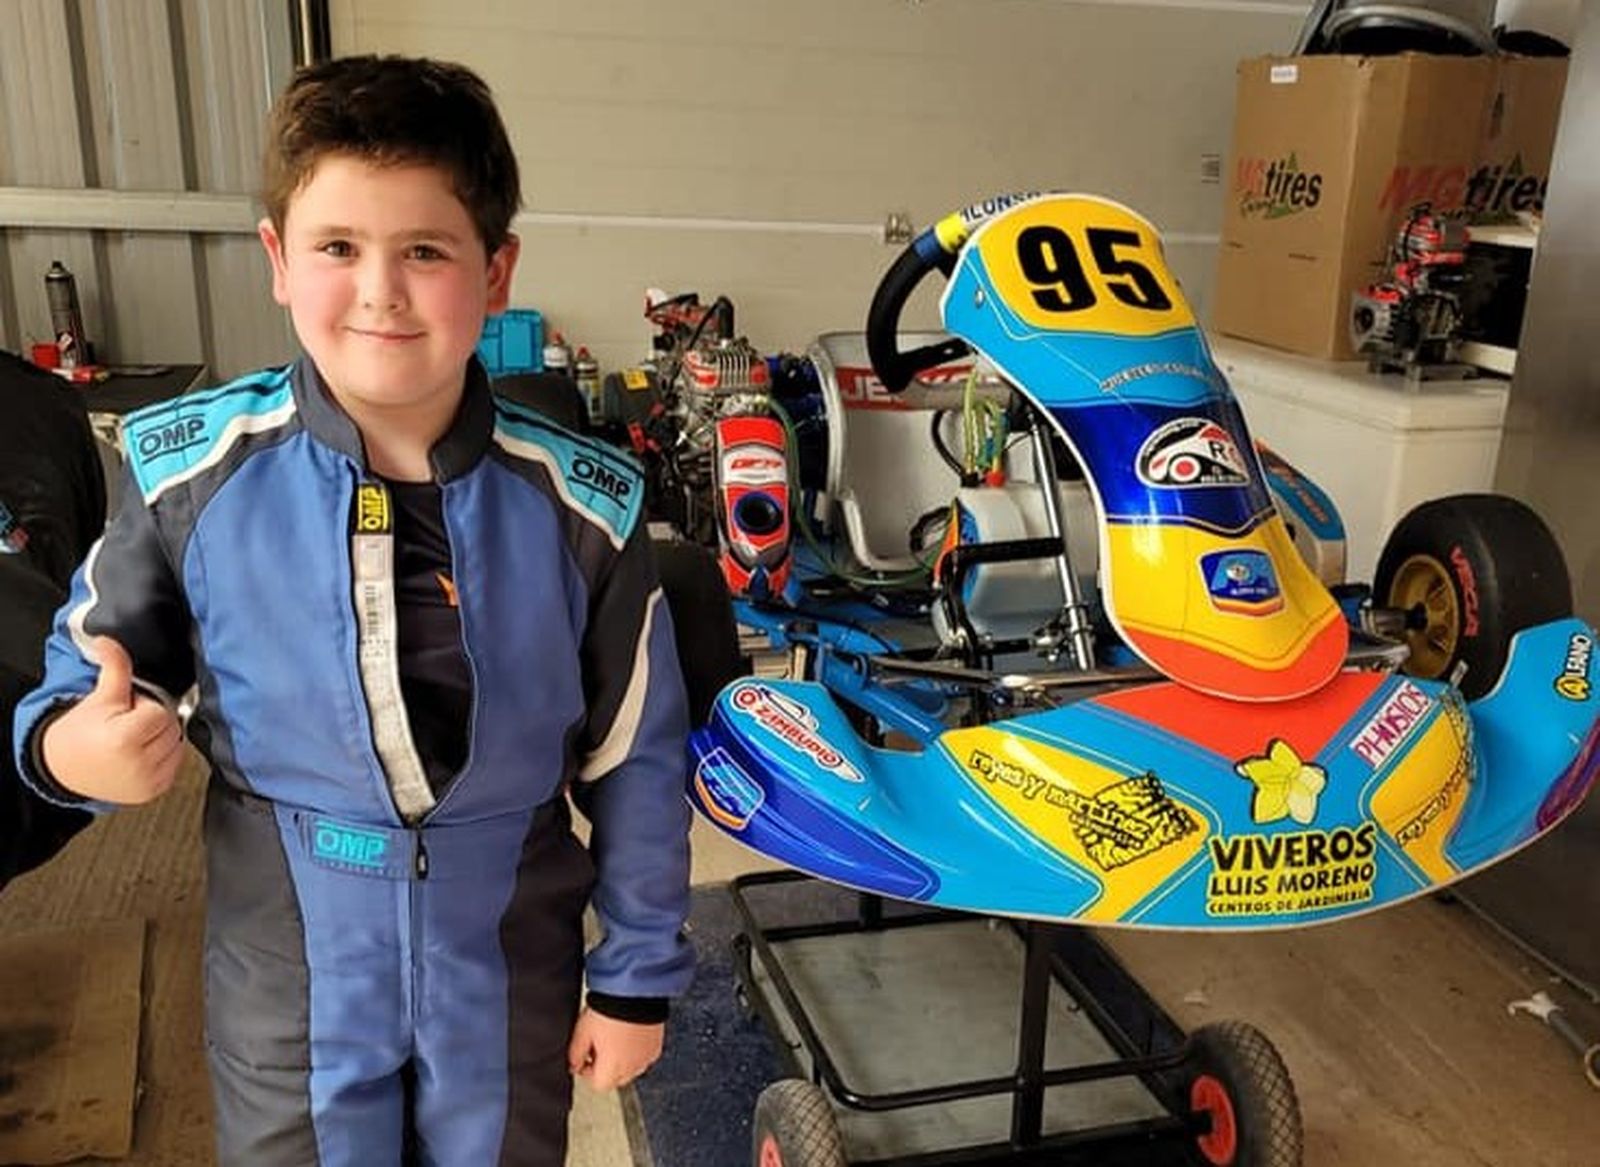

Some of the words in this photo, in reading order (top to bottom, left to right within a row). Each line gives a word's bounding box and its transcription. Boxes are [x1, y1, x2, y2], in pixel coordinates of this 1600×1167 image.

[1017, 226, 1173, 313] 95
[139, 418, 206, 456] OMP
[572, 458, 631, 498] OMP
[362, 485, 383, 531] OMP
[316, 829, 385, 861] OMP
[1211, 825, 1375, 871] VIVEROS
[1210, 875, 1269, 896] LUIS
[1277, 864, 1374, 894] MORENO
[1210, 902, 1271, 914] CENTROS
[1277, 901, 1293, 911] DE
